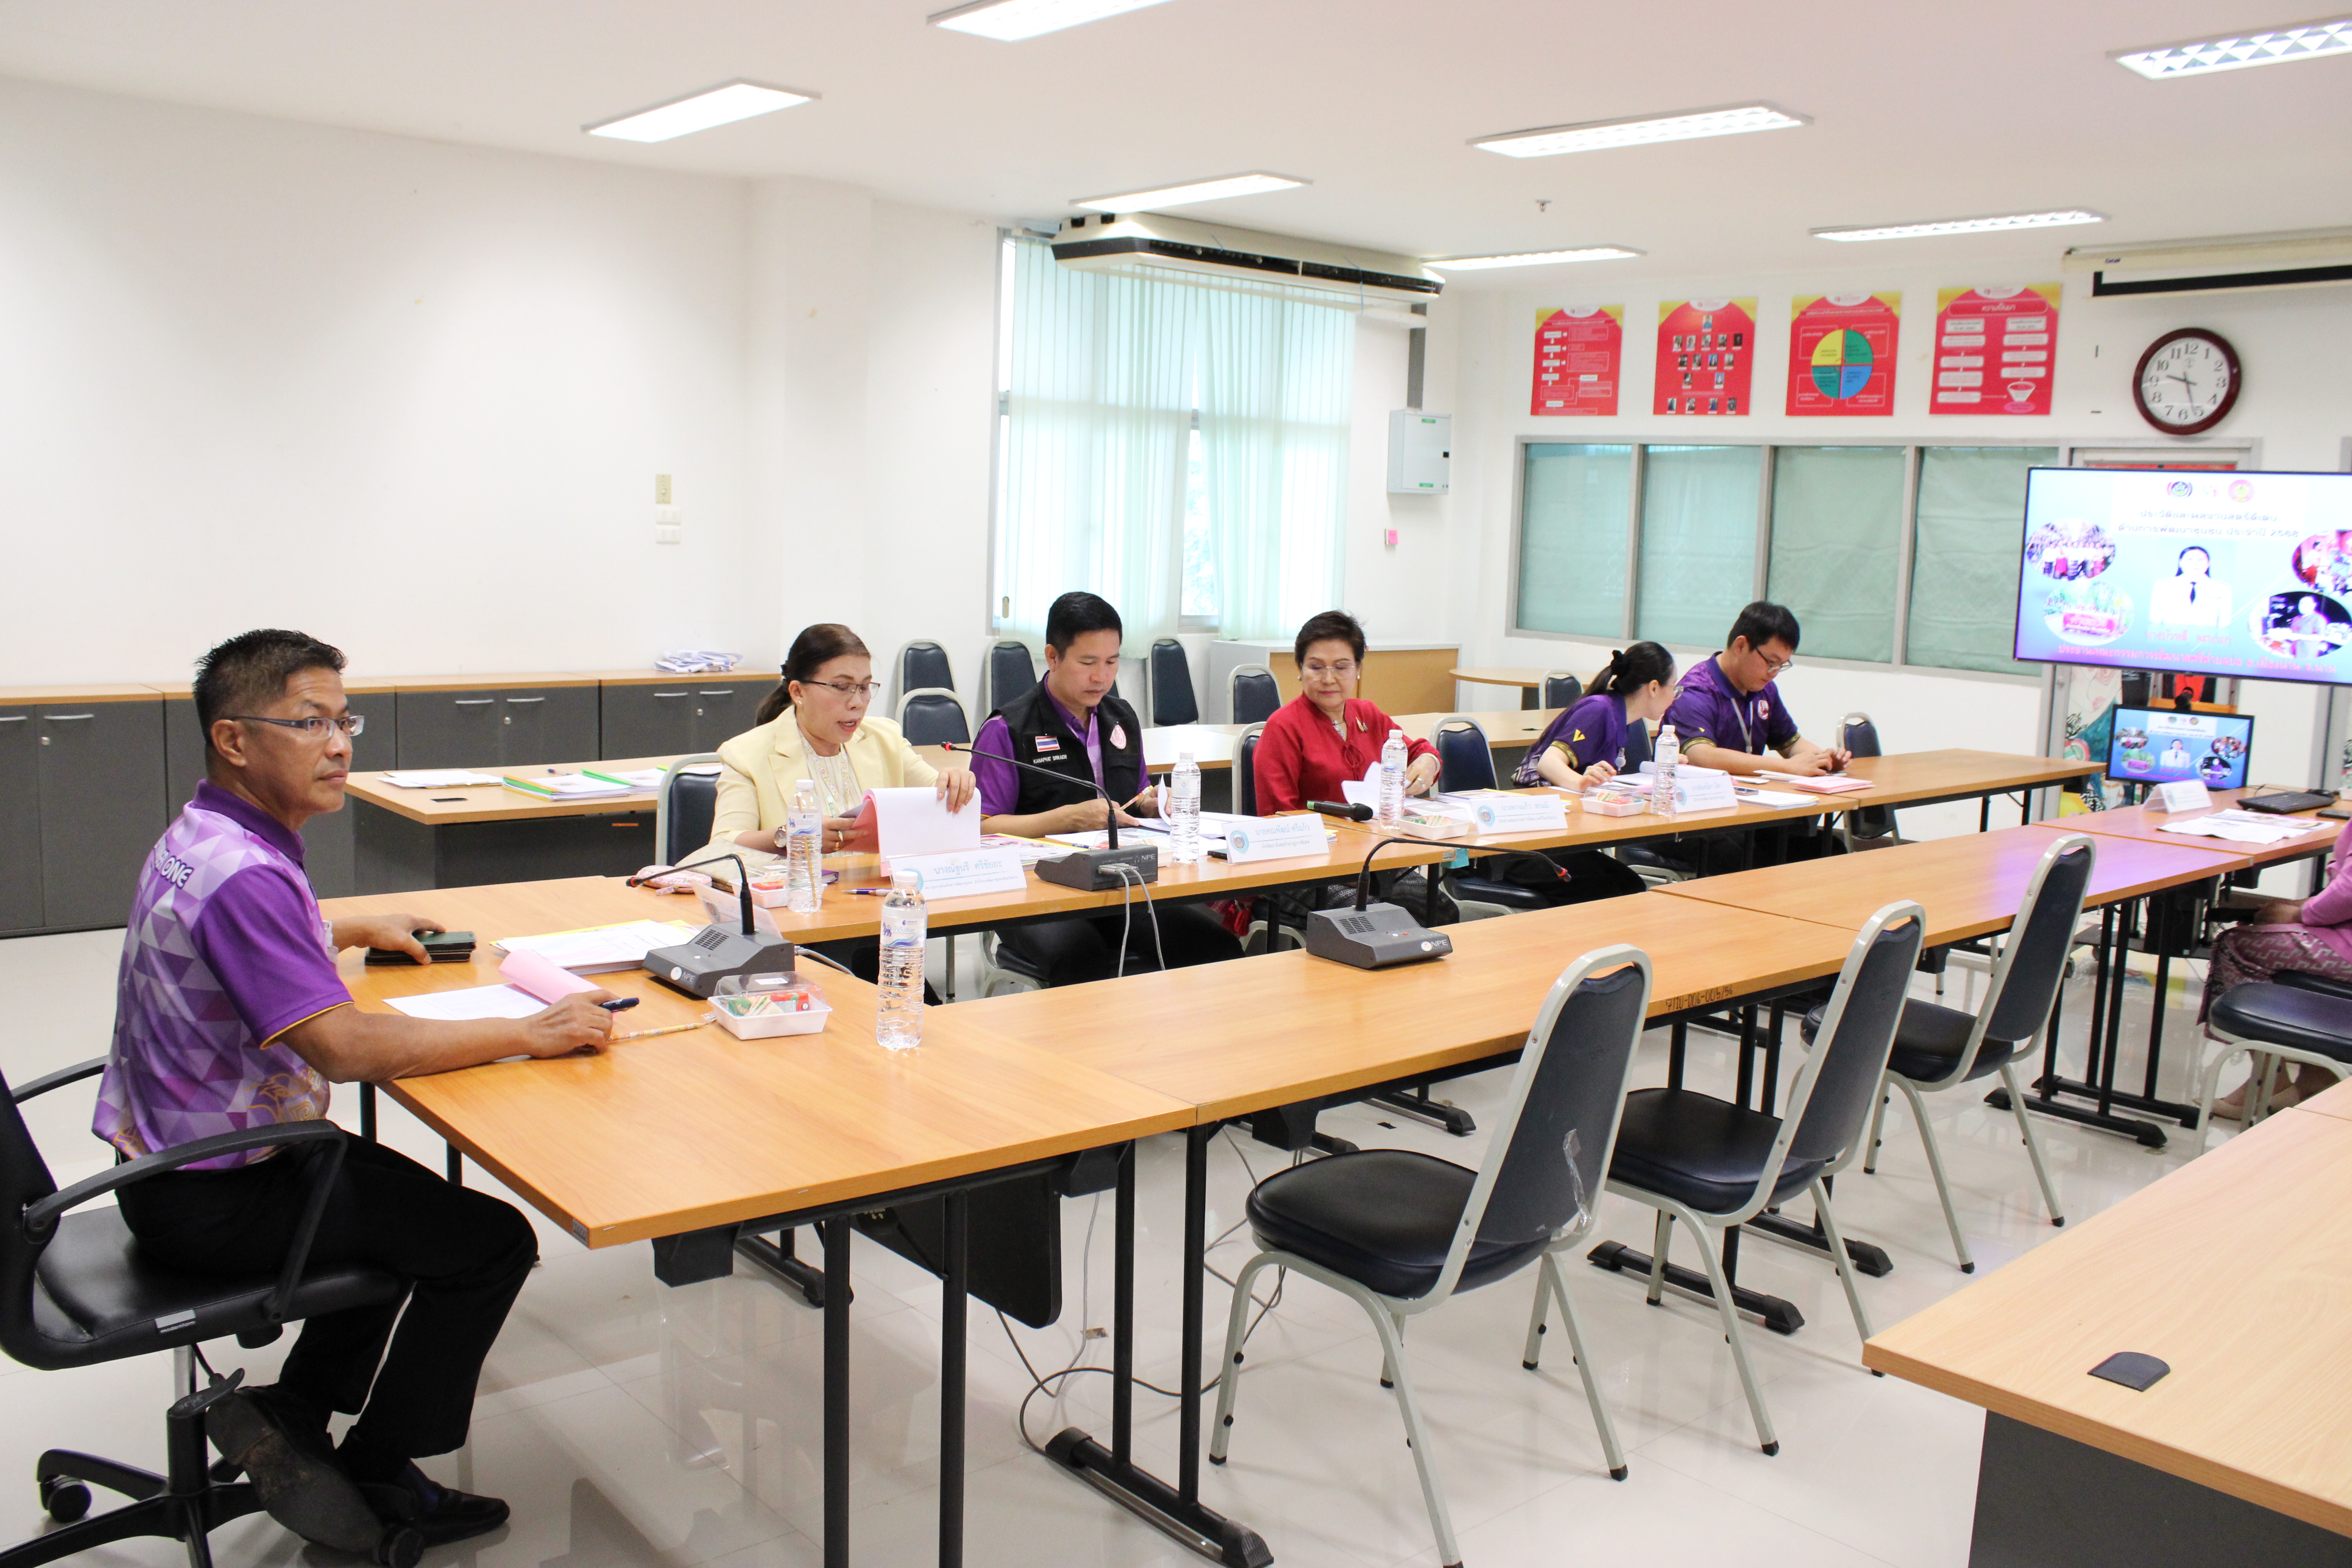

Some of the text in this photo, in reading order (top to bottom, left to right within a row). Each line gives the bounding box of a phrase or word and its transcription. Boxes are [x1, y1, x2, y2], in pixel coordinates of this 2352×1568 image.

[2171, 348, 2182, 359] 11
[2185, 343, 2199, 354] 12
[2205, 348, 2210, 359] 1
[2157, 359, 2169, 370] 10
[2214, 360, 2223, 372] 2
[2149, 376, 2159, 386] 9
[2216, 377, 2227, 388] 3
[2152, 392, 2161, 402] 8
[2207, 394, 2217, 404] 4
[2165, 405, 2173, 416] 7
[2178, 409, 2188, 420] 6
[2195, 406, 2204, 417] 5
[161, 856, 194, 889] ONE
